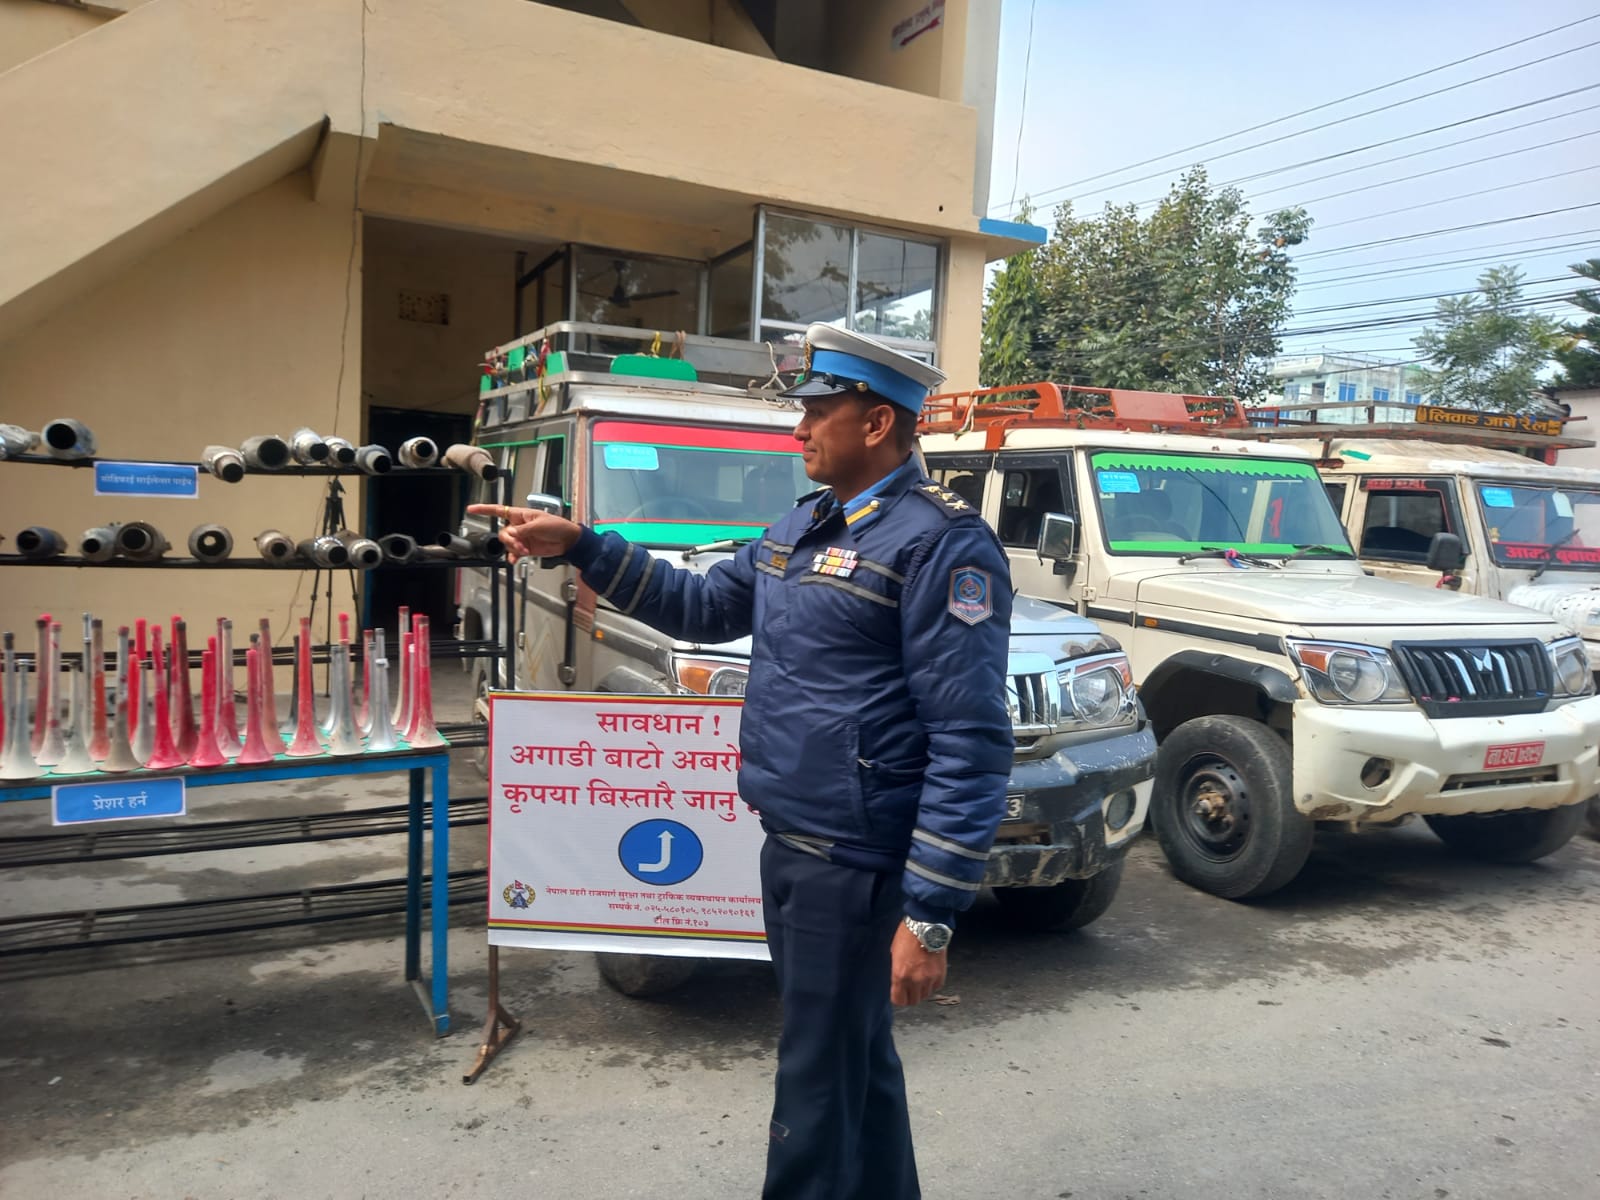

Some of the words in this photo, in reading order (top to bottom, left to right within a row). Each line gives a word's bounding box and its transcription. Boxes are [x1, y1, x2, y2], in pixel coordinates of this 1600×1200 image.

[596, 713, 704, 735] सावधान
[510, 741, 597, 767] अगाडी
[603, 741, 664, 769] बाटो
[672, 743, 741, 772] अबरो
[92, 794, 125, 810] प्रेशर
[127, 791, 148, 809] हर्न
[501, 784, 581, 813] कृपया
[587, 778, 675, 810] बिस्तारै
[682, 790, 738, 822] जानु
[546, 886, 568, 896] नेपाल
[569, 887, 586, 897] प्रहरी
